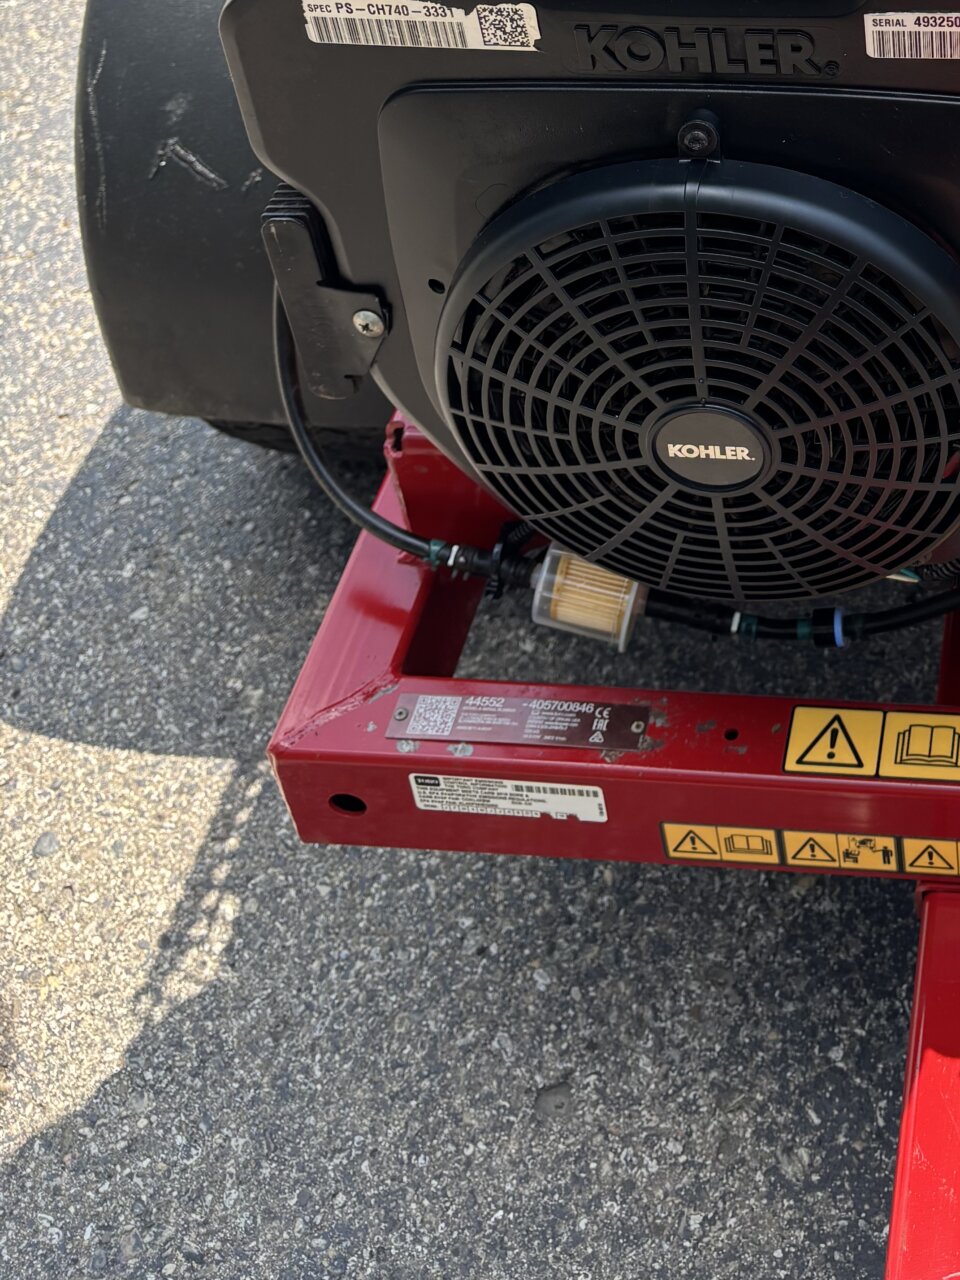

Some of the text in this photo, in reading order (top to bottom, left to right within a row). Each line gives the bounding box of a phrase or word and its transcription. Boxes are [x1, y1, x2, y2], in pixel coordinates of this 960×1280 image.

[307, 3, 332, 14] SPEC
[871, 18, 908, 28] SERIAL
[465, 696, 505, 708] 44552
